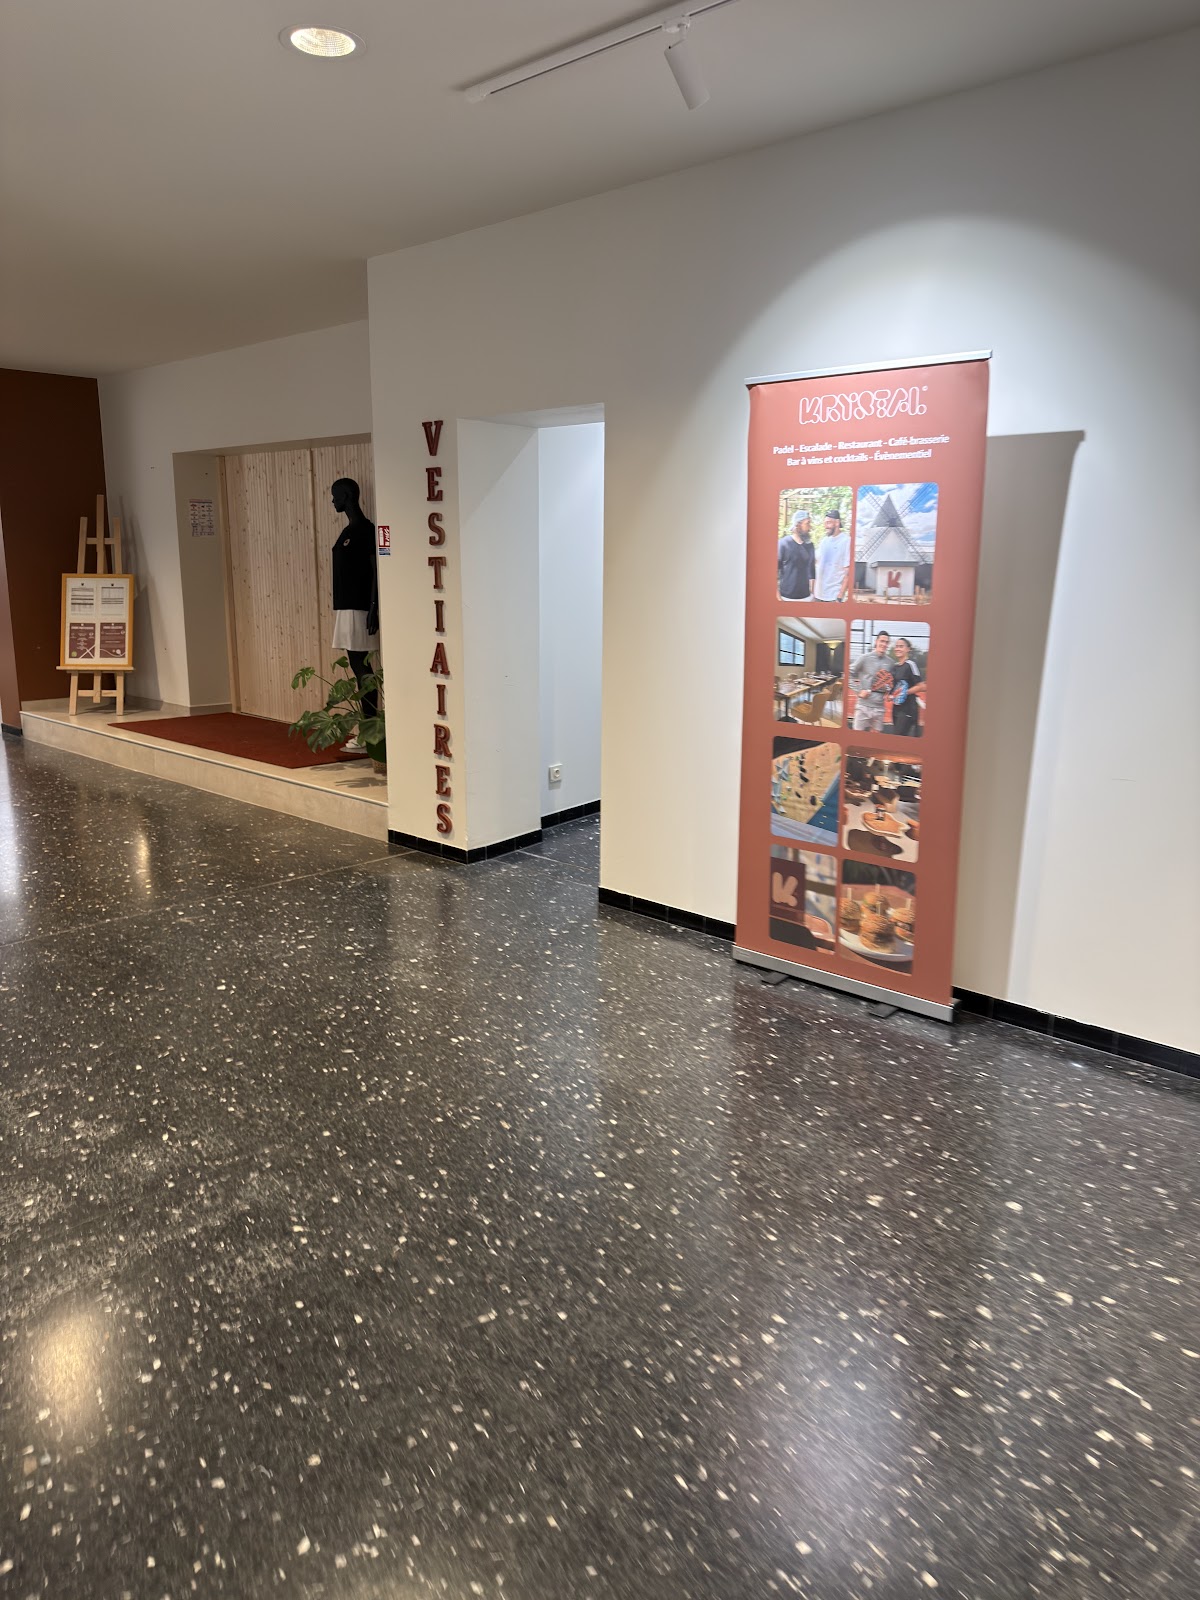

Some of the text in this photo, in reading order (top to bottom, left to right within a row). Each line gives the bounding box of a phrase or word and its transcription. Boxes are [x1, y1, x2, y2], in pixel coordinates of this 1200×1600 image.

[773, 445, 794, 454] Padel
[799, 443, 832, 452] Escalade
[838, 440, 882, 450] Restaurant
[888, 434, 950, 446] Café-brasserie
[787, 458, 800, 466] Bar
[801, 457, 806, 465] à
[807, 456, 823, 464] vins
[833, 453, 868, 463] cocktails
[422, 419, 453, 834] VESTIAIRES
